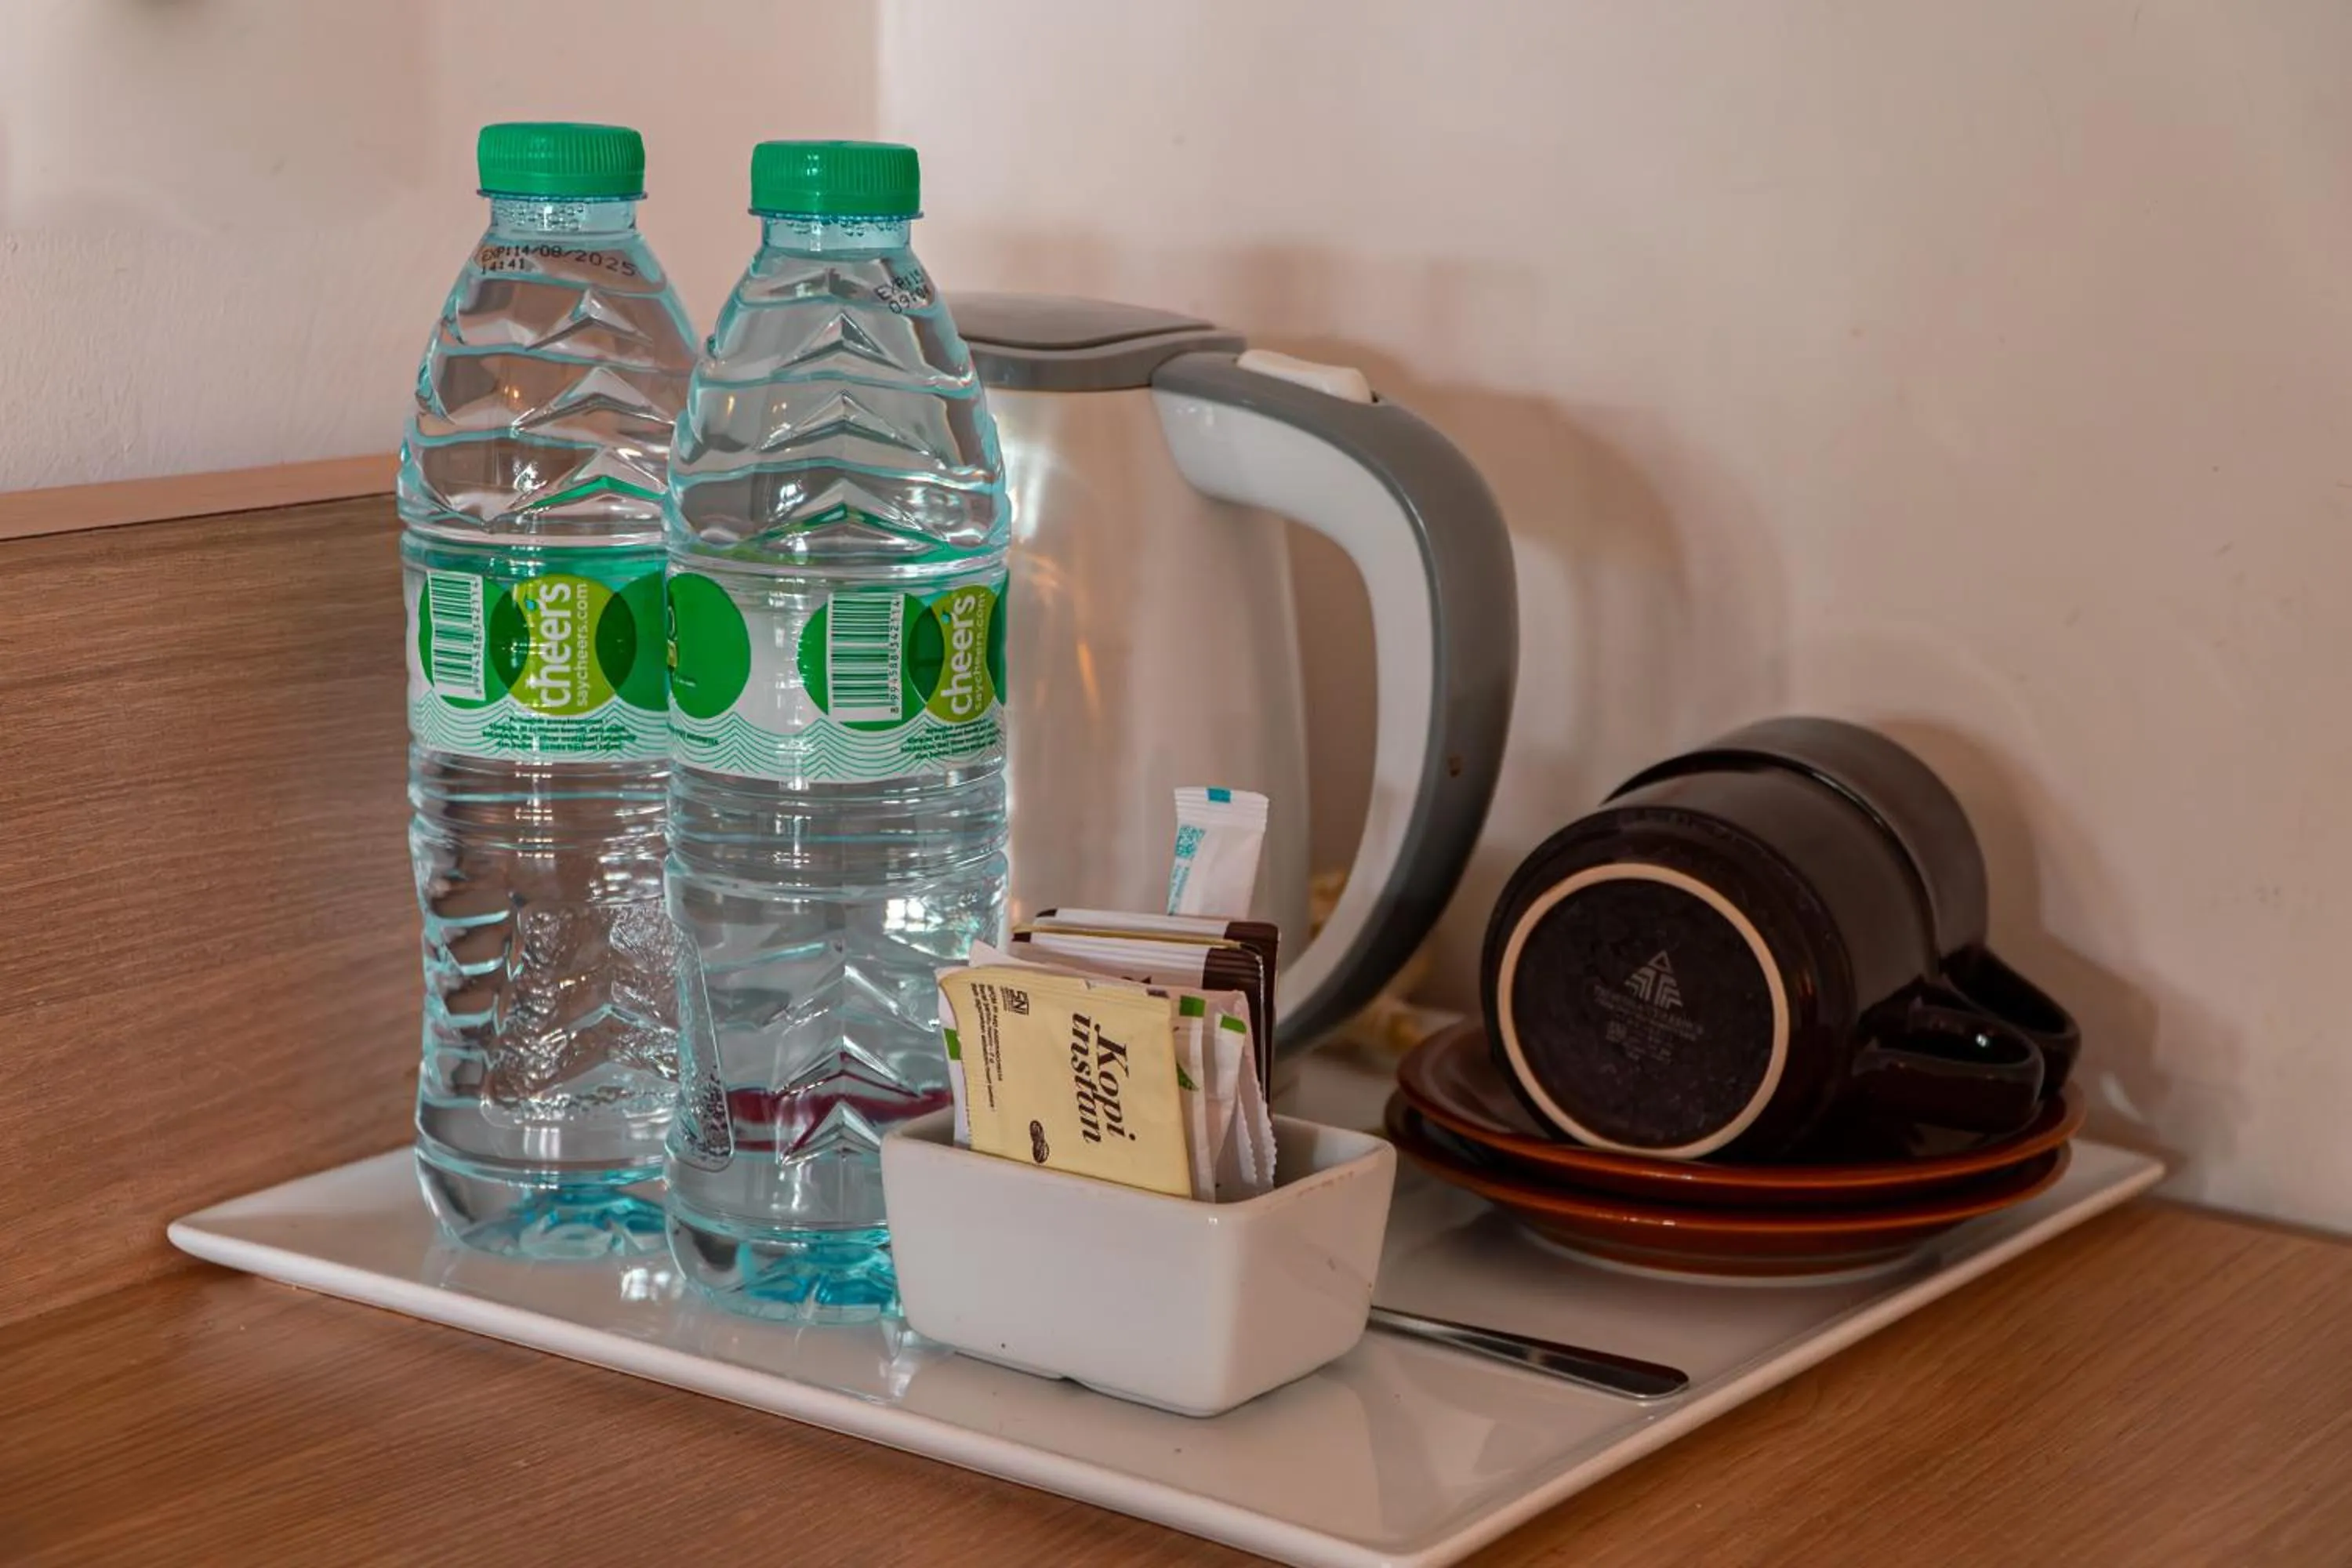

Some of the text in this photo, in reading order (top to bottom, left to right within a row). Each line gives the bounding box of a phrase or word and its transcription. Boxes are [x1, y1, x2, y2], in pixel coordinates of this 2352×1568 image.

[526, 583, 572, 707] cheers
[574, 583, 591, 706] saycheers.com
[941, 594, 976, 715] cheers
[1071, 1012, 1102, 1143] instan
[1094, 1031, 1136, 1142] Kopi
